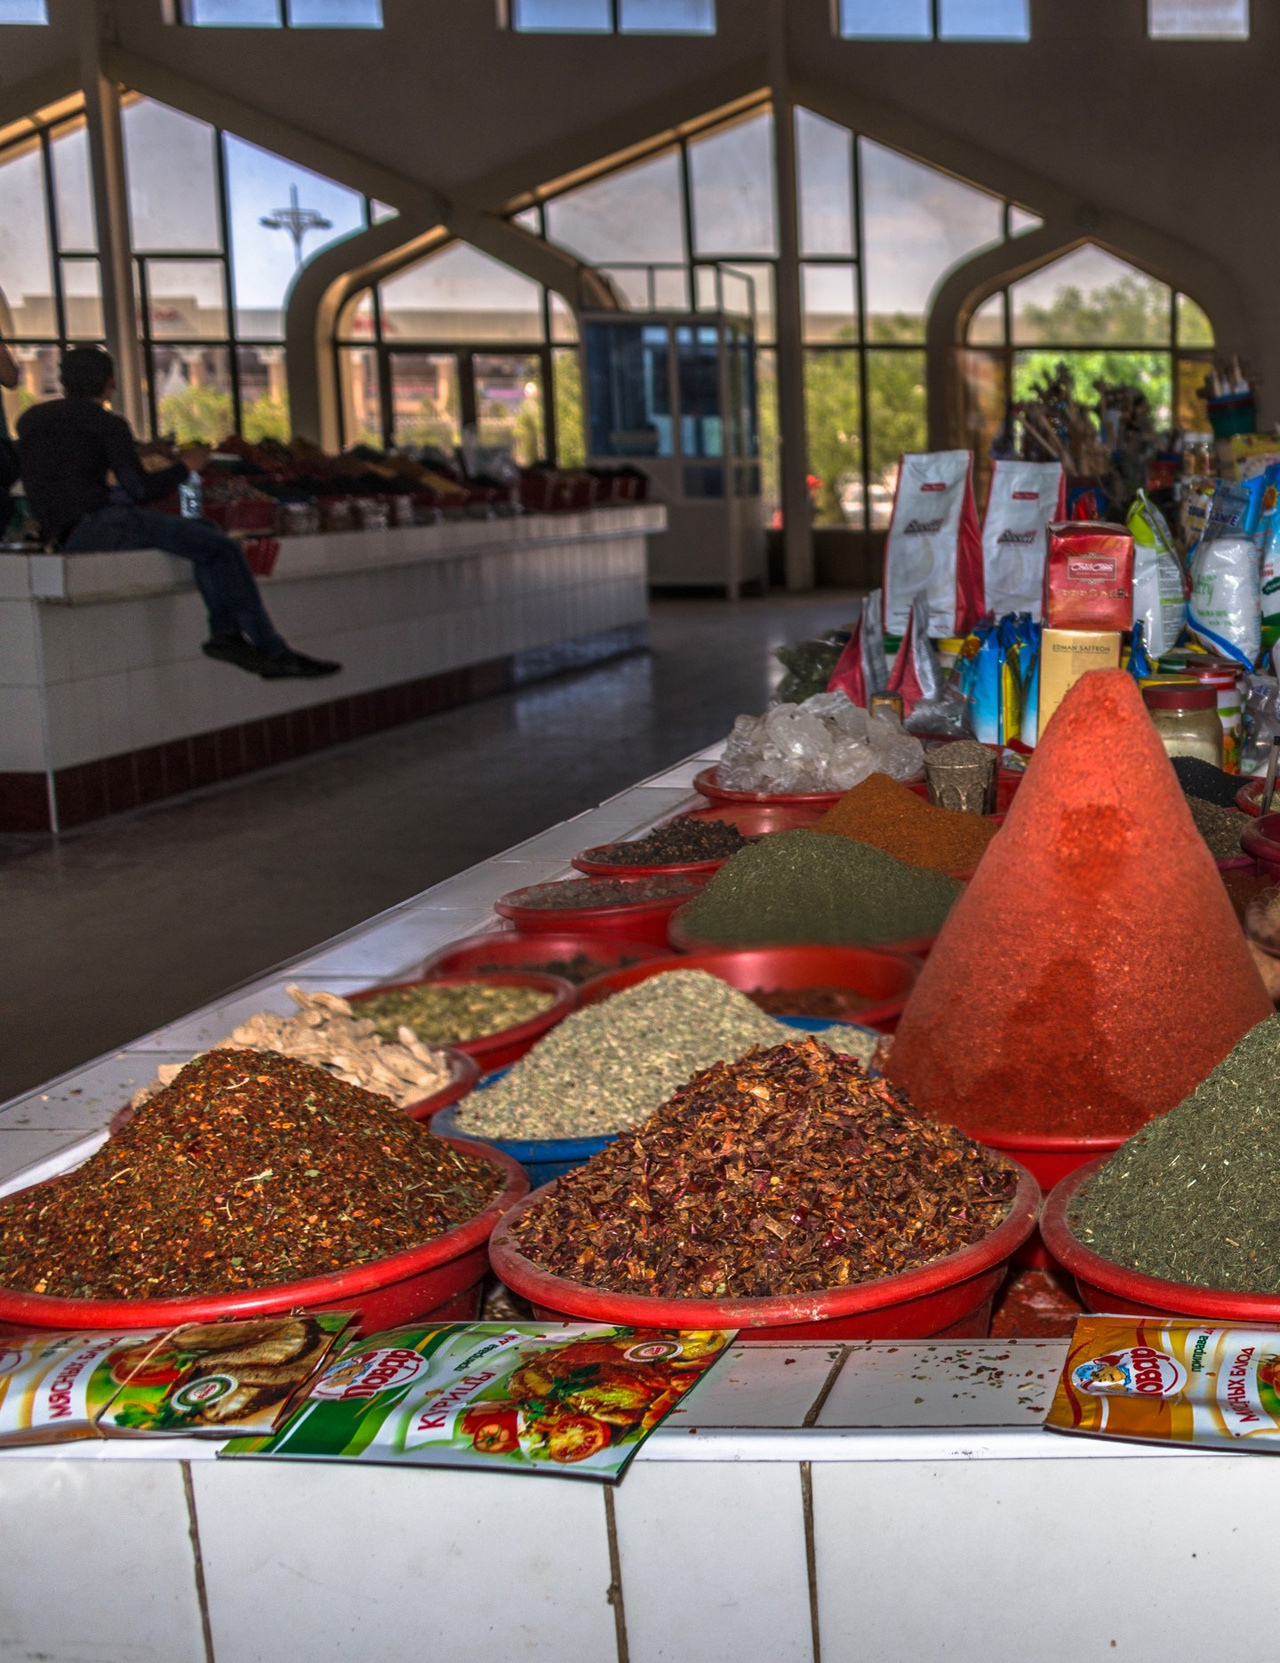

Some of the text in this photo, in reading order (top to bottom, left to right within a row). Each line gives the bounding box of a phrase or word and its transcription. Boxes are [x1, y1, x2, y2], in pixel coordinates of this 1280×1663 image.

[340, 1348, 424, 1400] Повар
[453, 1344, 500, 1372] приправа
[1131, 1346, 1171, 1397] овар
[1191, 1335, 1209, 1372] приправа
[48, 1360, 89, 1419] МЯСНЫХ
[417, 1371, 497, 1431] КУРИЦЫ
[1227, 1346, 1261, 1423] МЯСНЫХ БЛЮД
